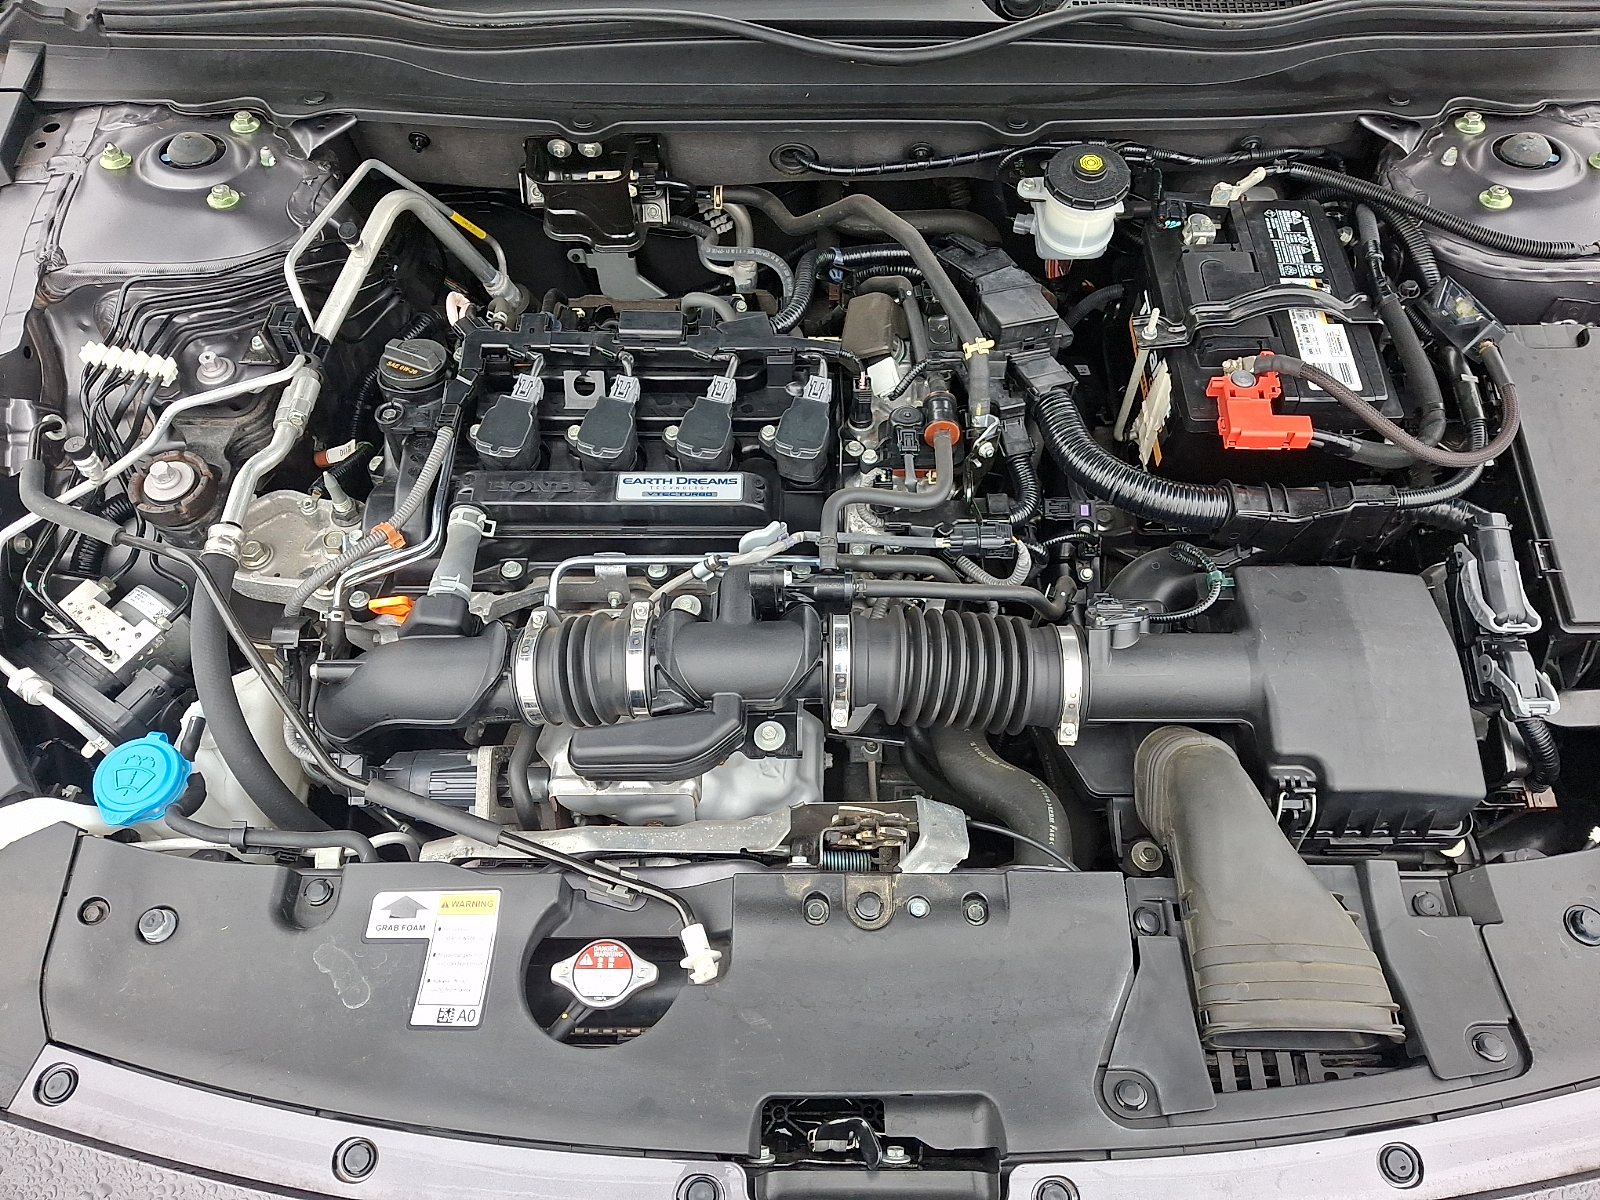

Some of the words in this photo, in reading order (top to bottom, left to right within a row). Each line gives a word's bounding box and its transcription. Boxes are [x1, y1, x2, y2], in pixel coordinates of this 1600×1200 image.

[386, 361, 400, 369] SAE
[622, 477, 673, 485] EARTH
[676, 476, 738, 485] DREAMS
[487, 481, 597, 493] HONDA
[451, 900, 494, 908] WARNING
